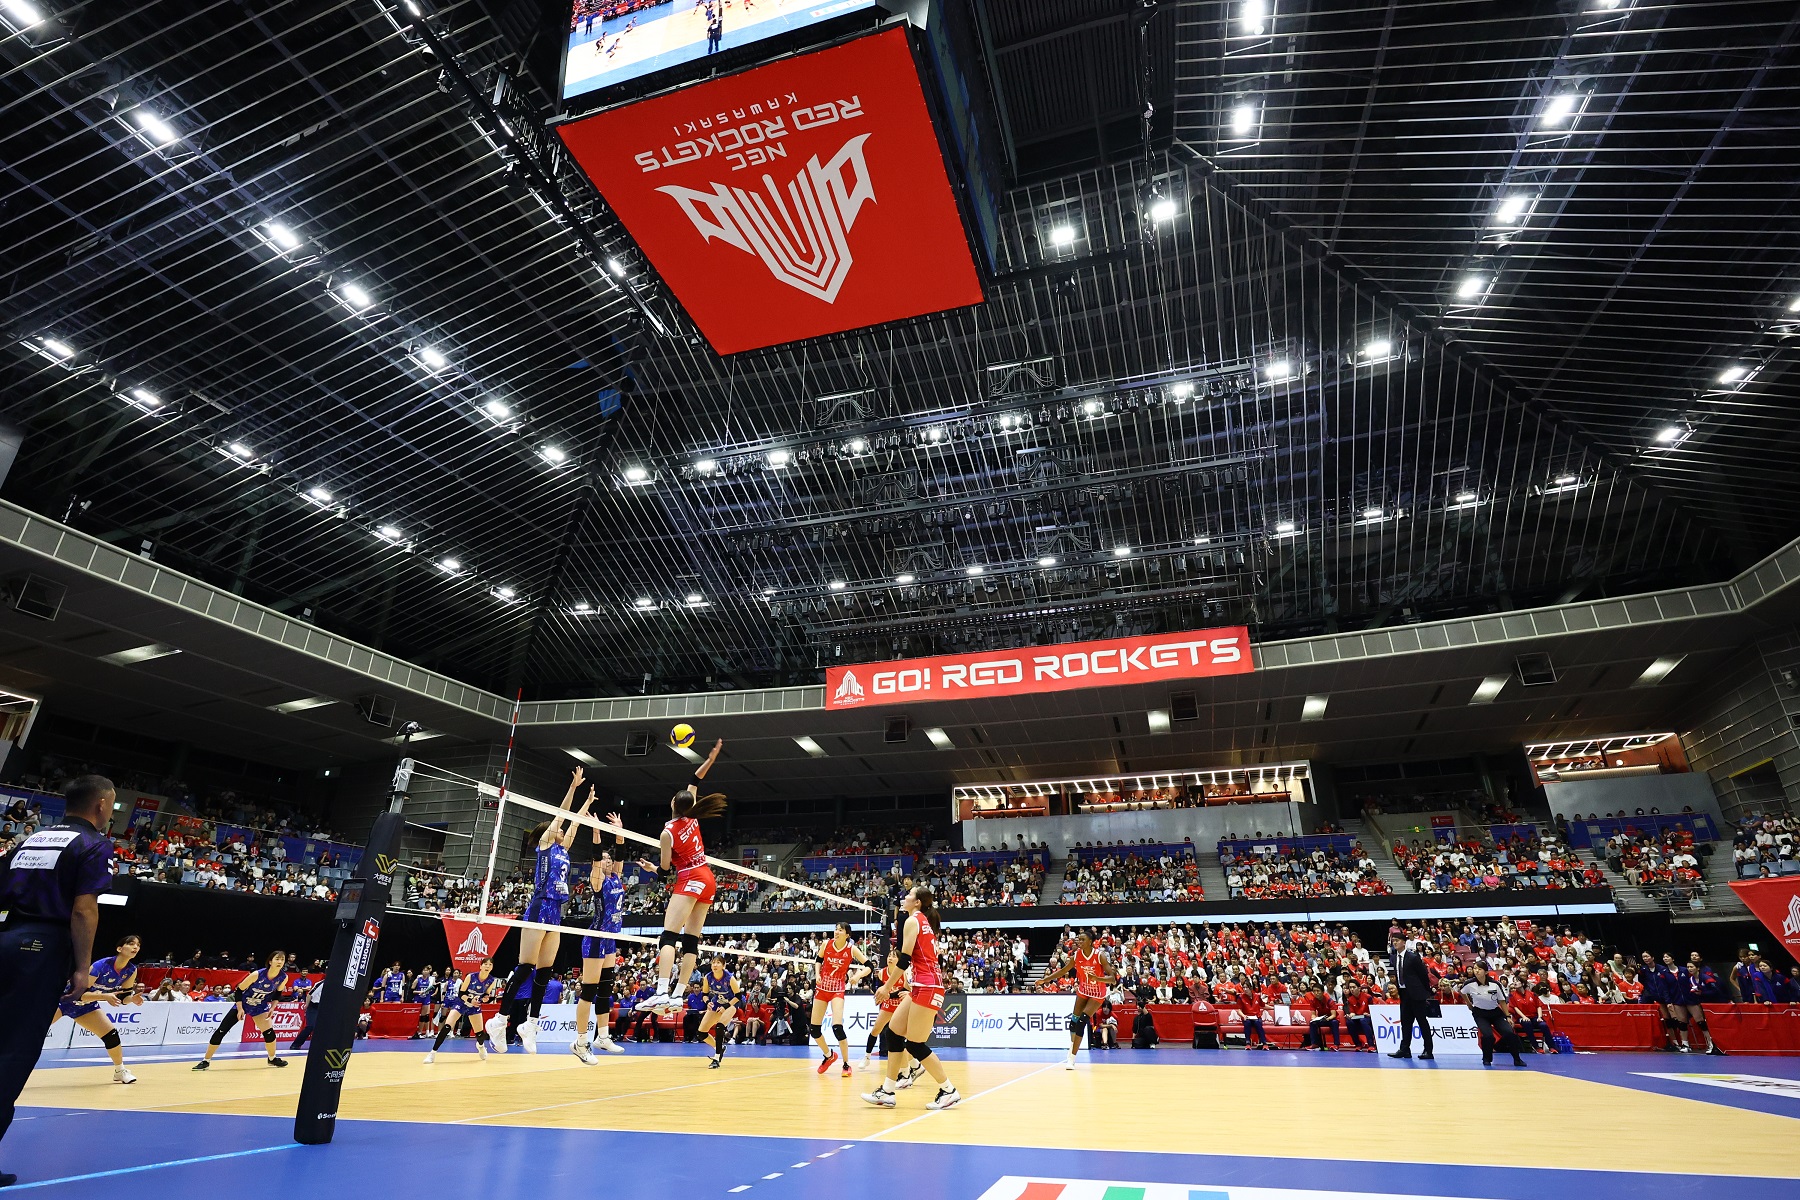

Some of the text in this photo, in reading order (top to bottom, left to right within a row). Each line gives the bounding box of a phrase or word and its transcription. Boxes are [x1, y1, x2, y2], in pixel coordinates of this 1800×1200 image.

[673, 92, 799, 137] KAWASAKI
[634, 95, 865, 173] RED ROCKETS
[725, 142, 787, 172] NEC
[872, 637, 1241, 695] GO! RED ROCKETS
[692, 835, 702, 851] 2
[346, 939, 363, 984] オンデマンド
[359, 938, 372, 970] SPORTS
[827, 957, 845, 965] NEC
[830, 965, 840, 976] 7
[106, 1013, 141, 1023] NEC
[192, 1013, 222, 1022] NEC
[848, 1011, 879, 1031] 大同
[944, 1007, 959, 1022] LEAGUE
[559, 1021, 594, 1031] 大同命
[930, 1026, 958, 1035] 大同生命
[972, 1018, 1003, 1032] DAIDO
[1378, 1026, 1478, 1044] DAIO 大同生命
